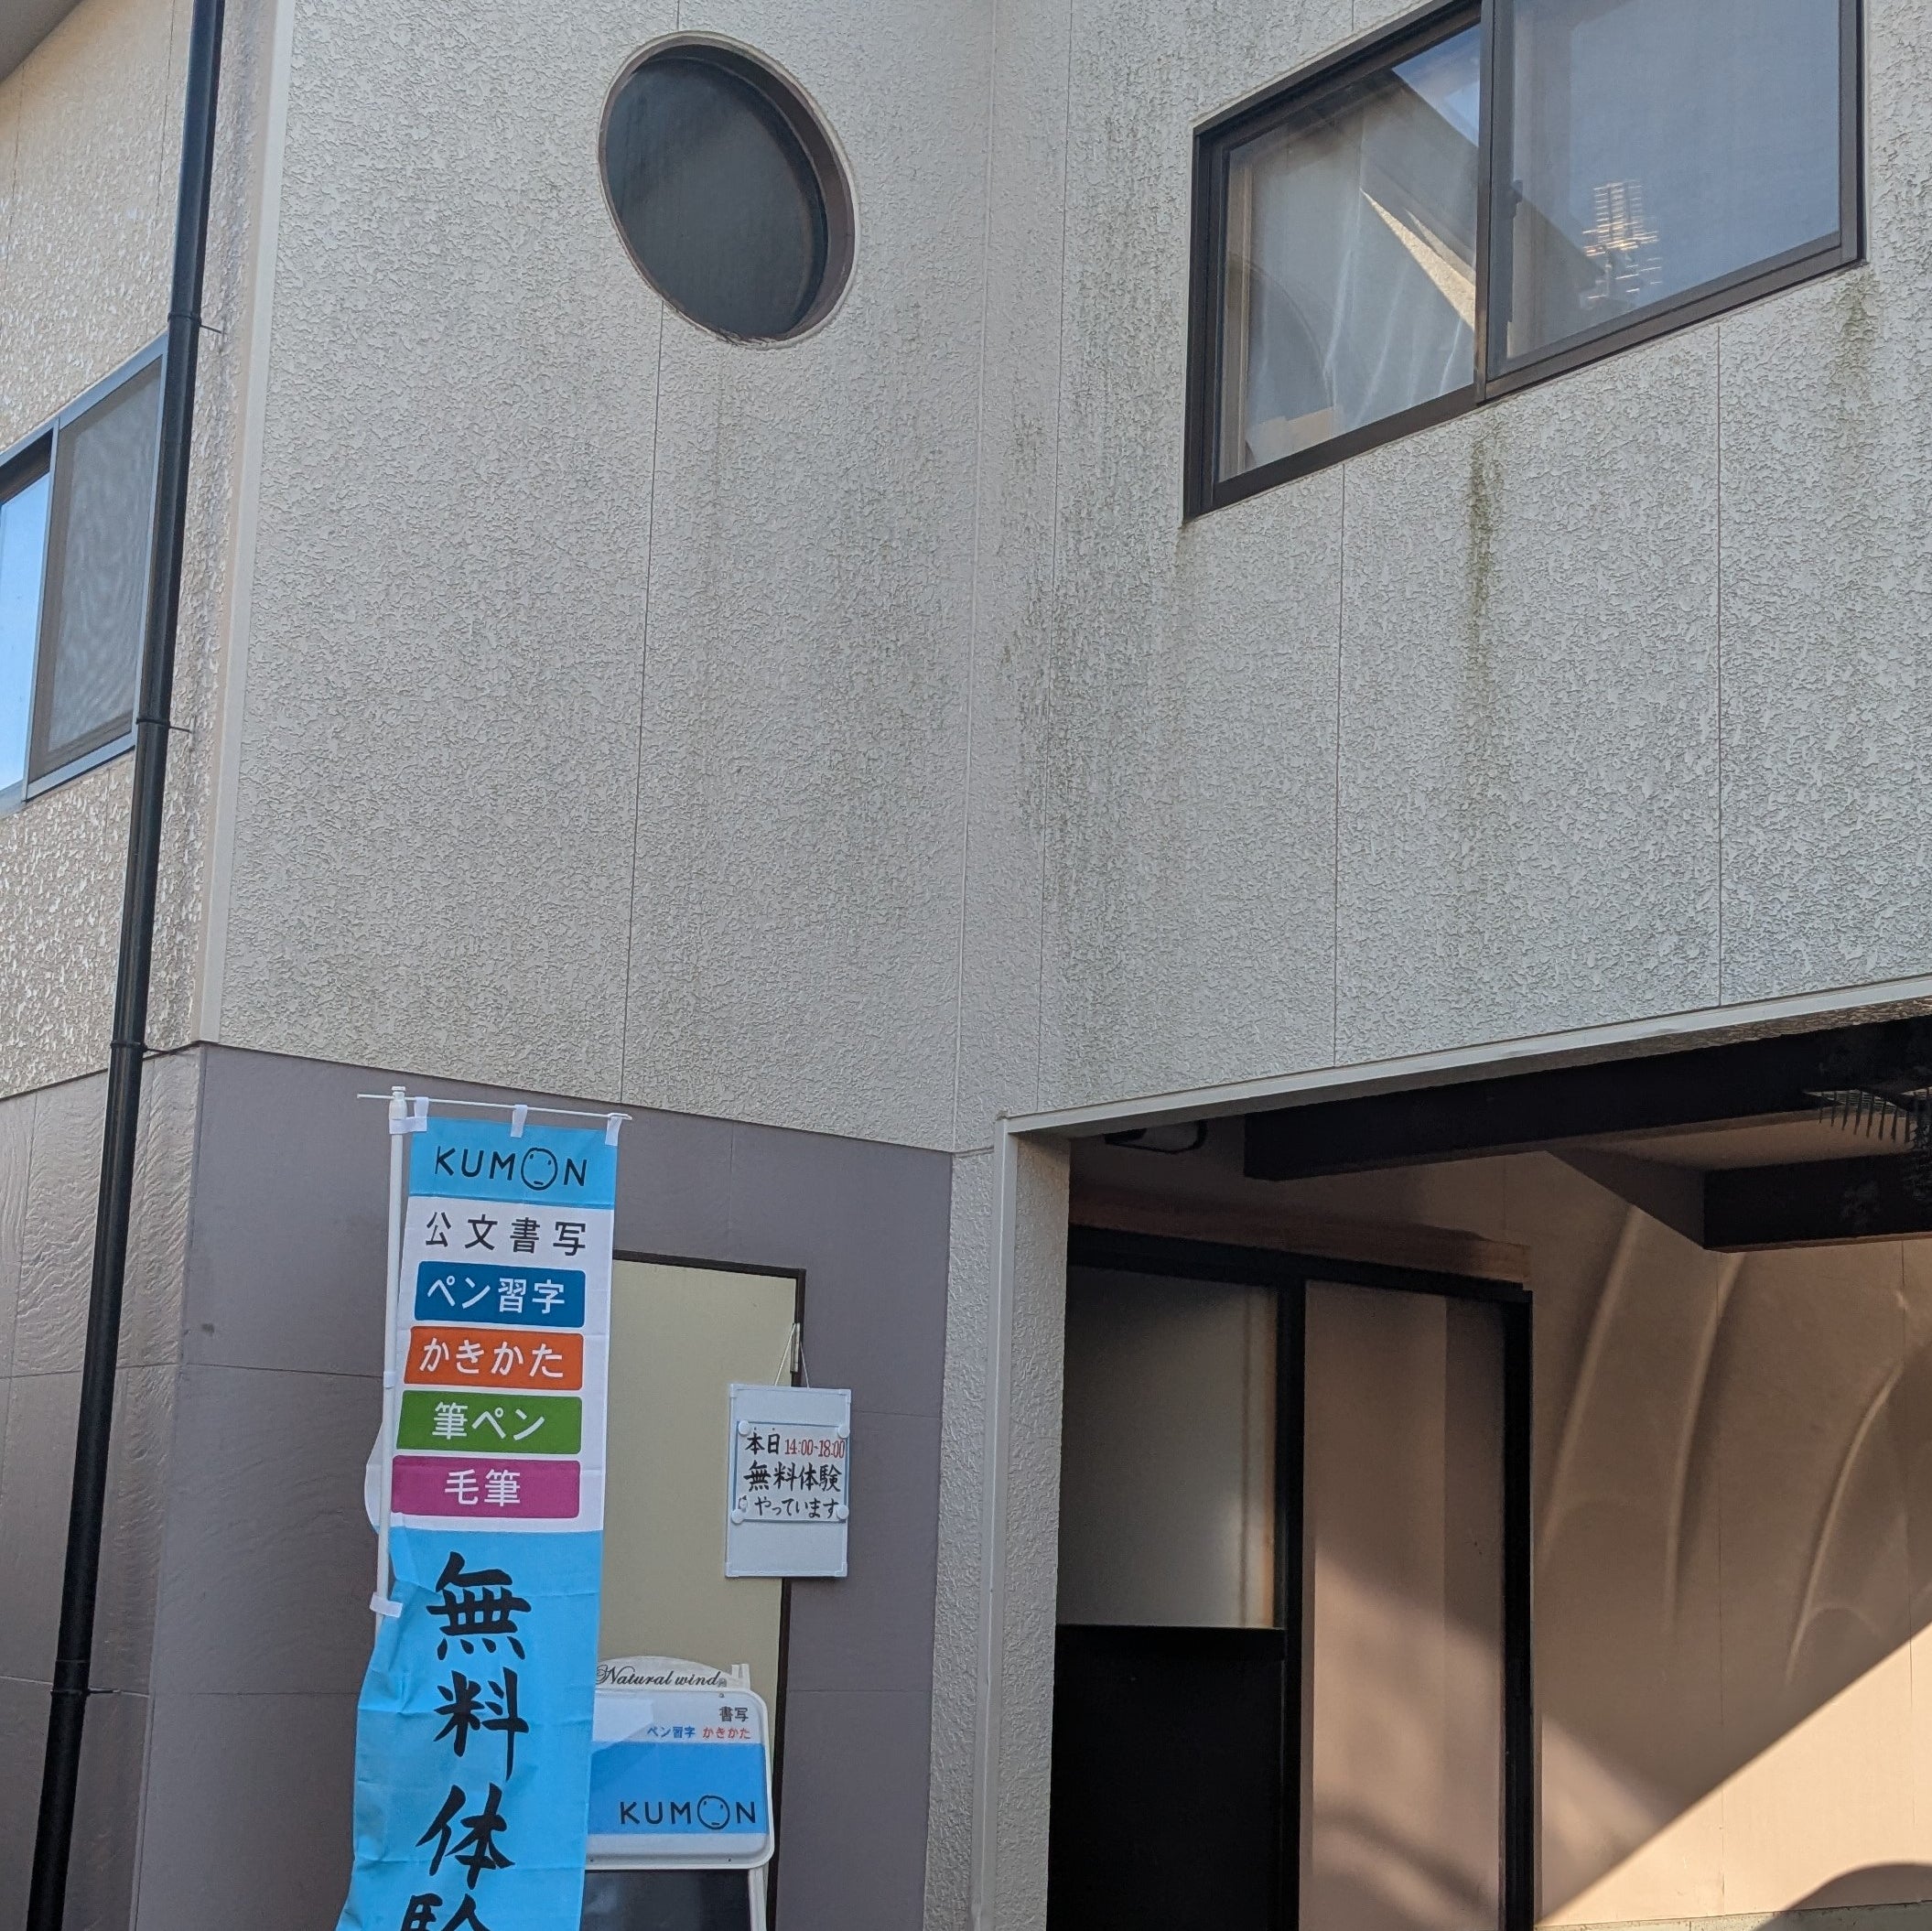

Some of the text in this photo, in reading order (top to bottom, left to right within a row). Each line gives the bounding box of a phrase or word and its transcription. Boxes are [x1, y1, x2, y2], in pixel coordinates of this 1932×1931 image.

[435, 1146, 588, 1191] KUMON
[426, 1212, 586, 1257] 公文書写
[427, 1275, 566, 1314] ペン習字
[419, 1337, 564, 1378] かきかた
[432, 1401, 545, 1440] 筆ペン
[744, 1431, 781, 1455] 本日
[445, 1469, 521, 1506] 毛筆
[743, 1460, 842, 1493] 無料体験
[754, 1496, 839, 1518] やっています
[596, 1664, 721, 1686] Natural wind
[719, 1706, 749, 1722] 書写
[647, 1726, 751, 1740] ペン習字 かきかた
[620, 1795, 756, 1830] KUMON
